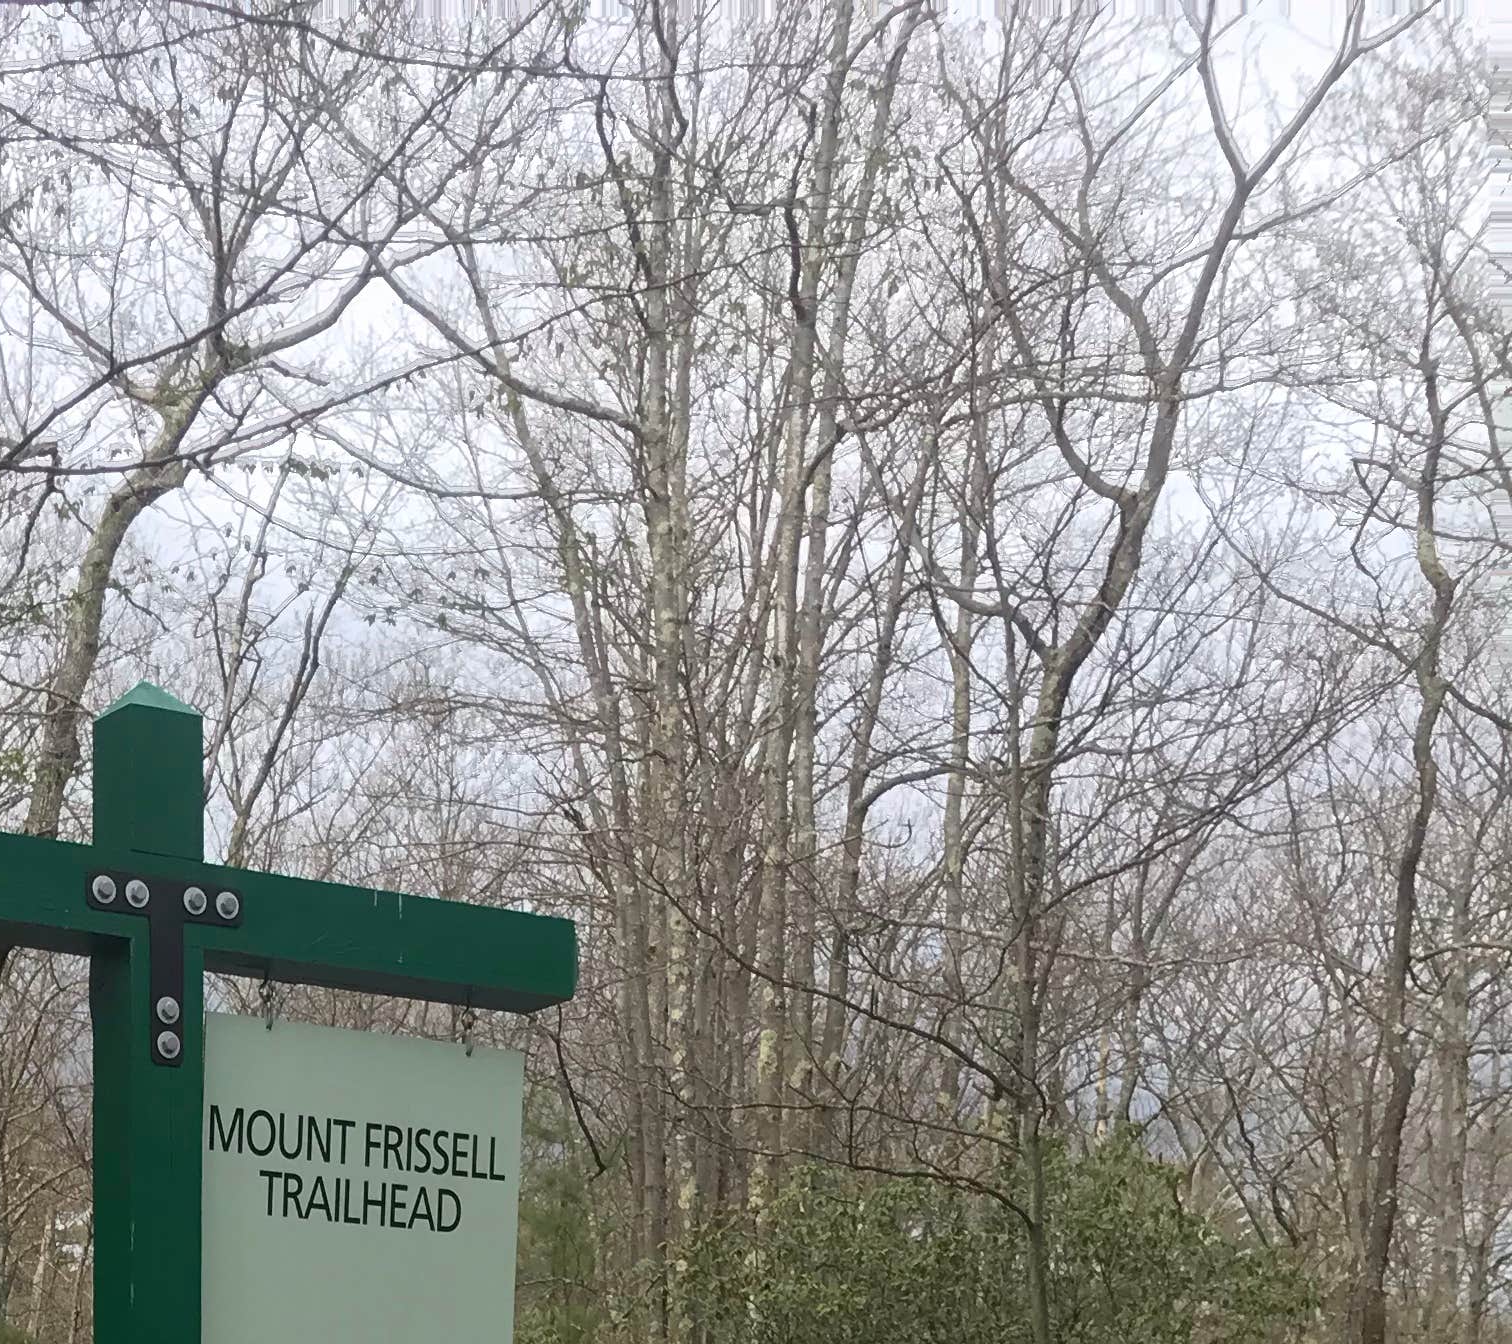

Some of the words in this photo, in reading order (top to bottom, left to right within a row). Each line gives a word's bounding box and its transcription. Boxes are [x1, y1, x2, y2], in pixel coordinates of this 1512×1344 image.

[208, 1105, 355, 1163] MOUNT
[364, 1122, 506, 1181] FRISSELL
[259, 1169, 462, 1233] TRAILHEAD
